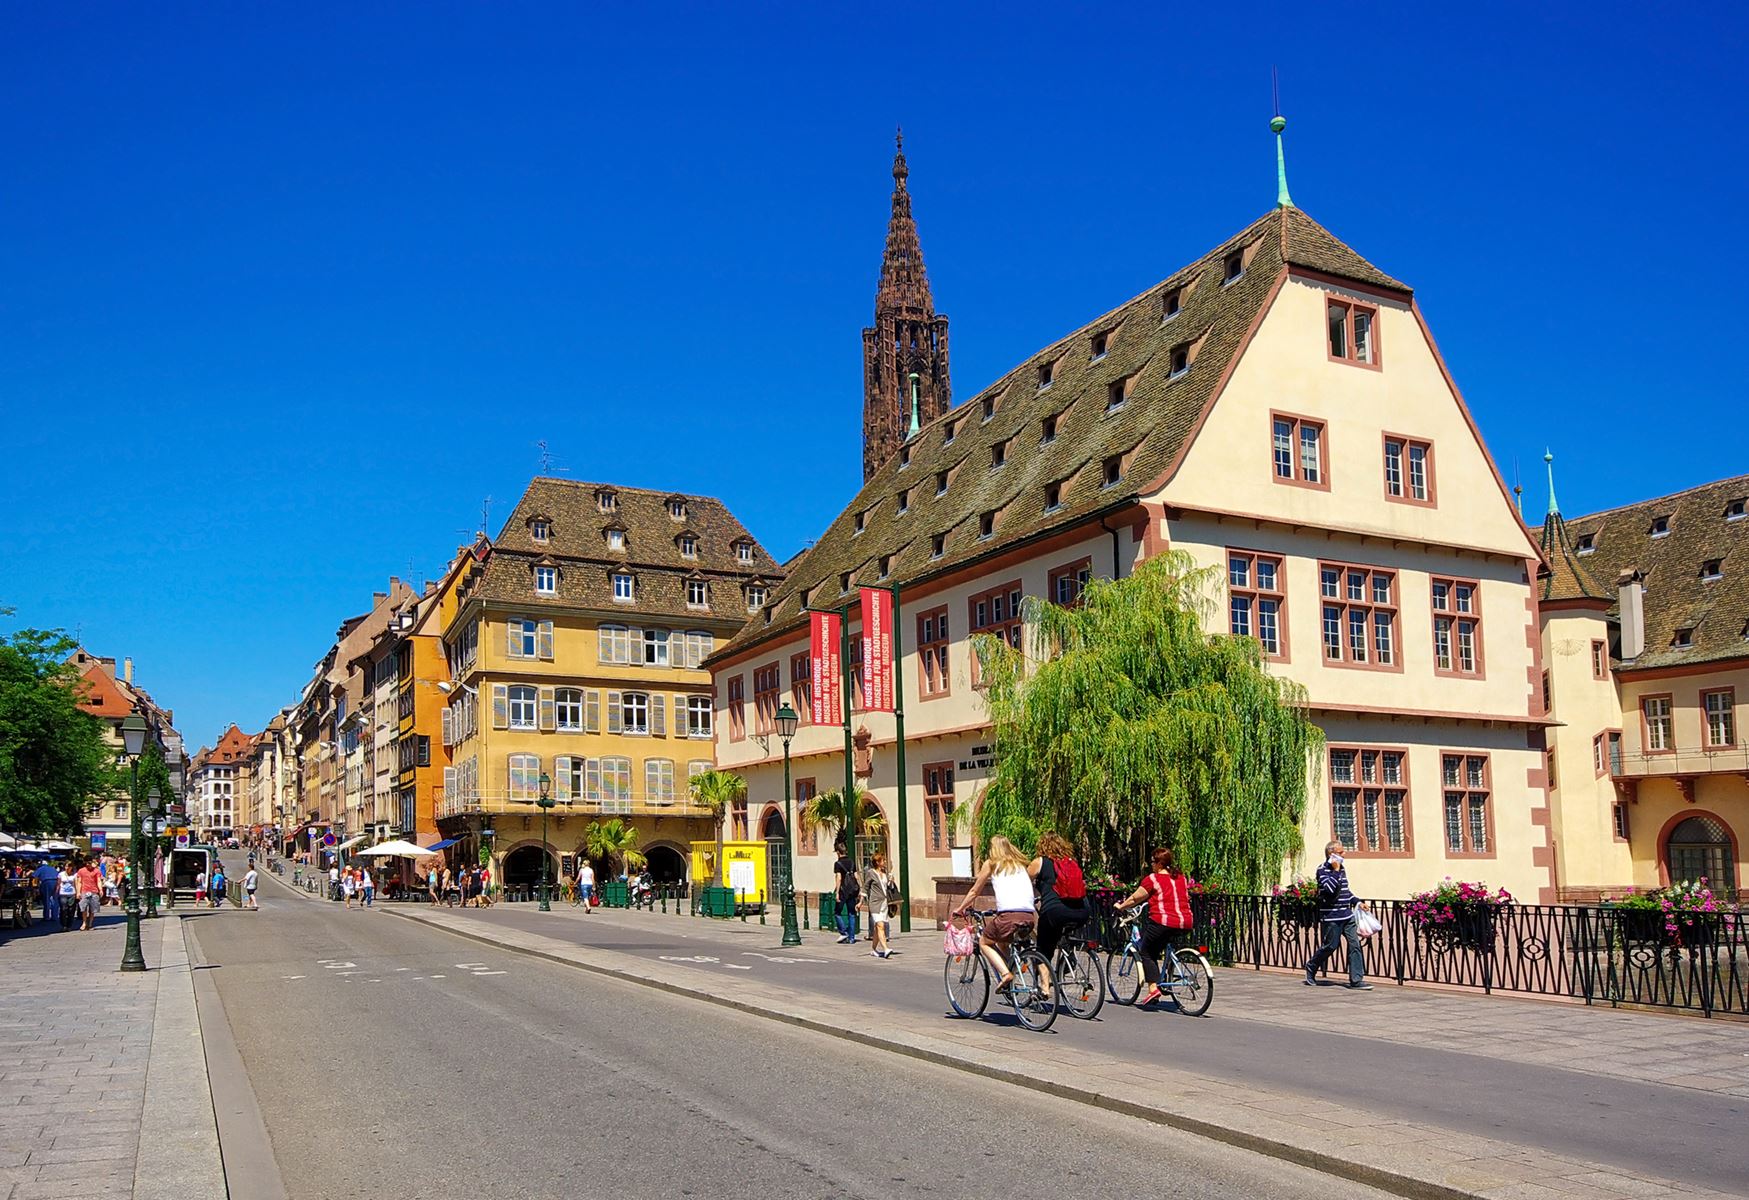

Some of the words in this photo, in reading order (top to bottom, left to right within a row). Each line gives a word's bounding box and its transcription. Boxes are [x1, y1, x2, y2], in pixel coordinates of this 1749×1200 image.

[872, 591, 880, 658] STADTGESCHICHTE
[822, 615, 830, 677] STADTGESCHICHTE
[864, 637, 872, 680] HISTORIQUE
[881, 633, 889, 665] MUSEUM
[814, 658, 822, 698] HISTORIQUE
[830, 653, 838, 683] MUSEUM
[873, 659, 881, 673] FÜR
[822, 678, 830, 692] FÜR
[864, 682, 873, 708] MUSÉE
[874, 675, 882, 708] MUSEUM
[882, 667, 891, 709] HISTORICAL
[814, 699, 822, 723] MUSÉE
[823, 693, 831, 723] MUSEUM
[831, 685, 839, 723] HISTORICAL
[968, 761, 976, 769] LA
